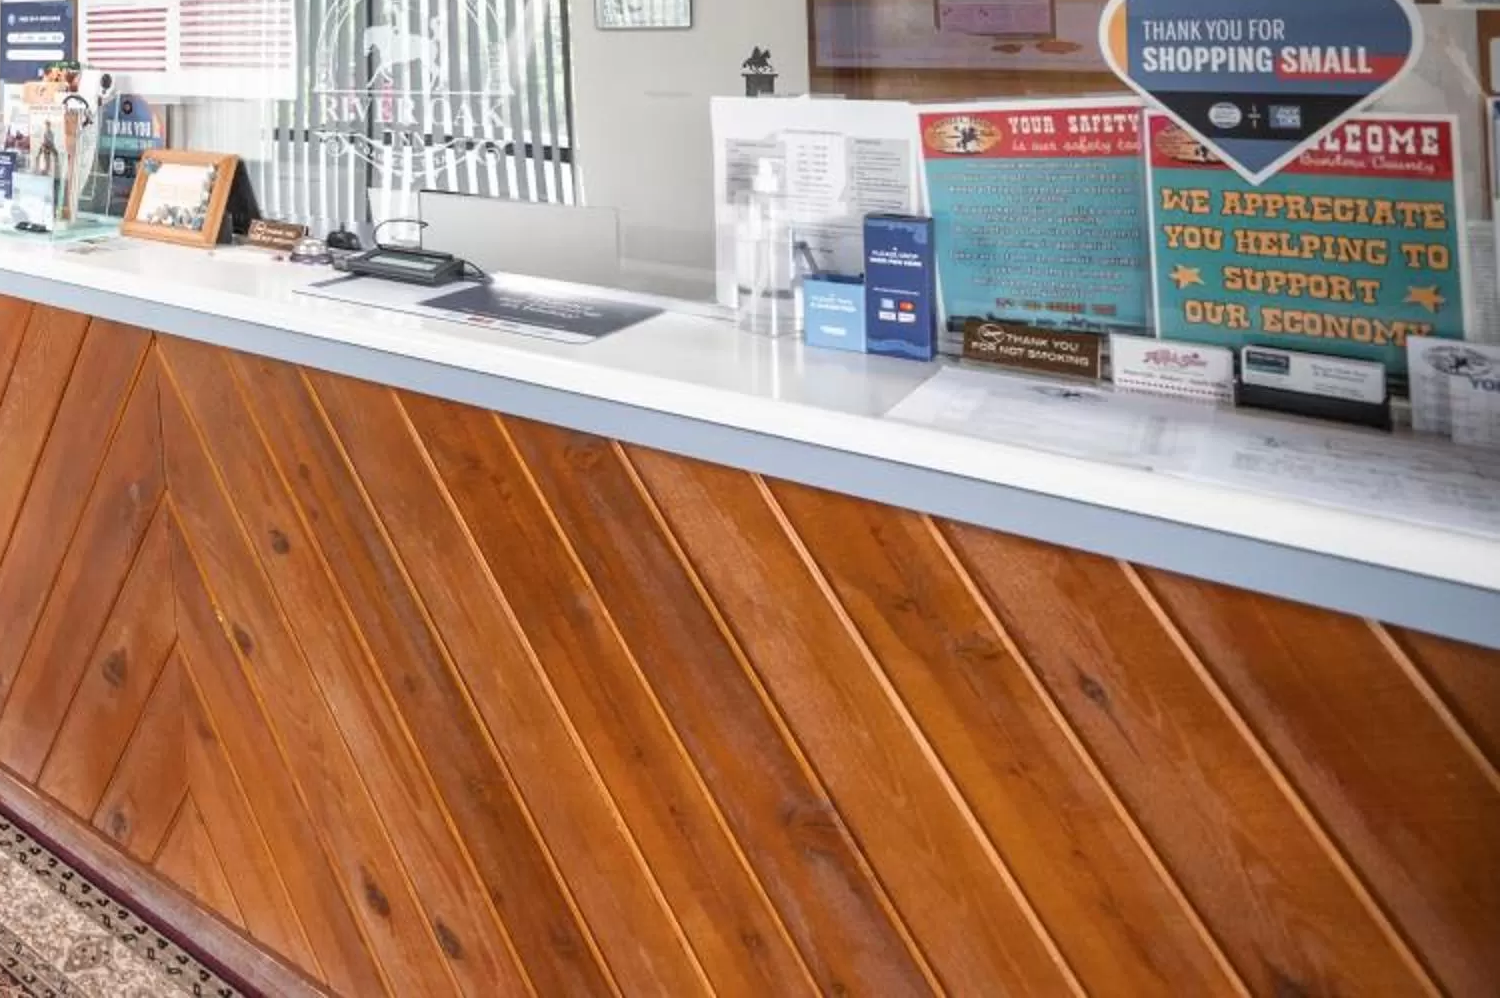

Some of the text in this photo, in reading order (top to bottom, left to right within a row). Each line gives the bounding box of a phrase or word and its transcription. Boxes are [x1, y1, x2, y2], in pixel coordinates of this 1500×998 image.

[1142, 19, 1285, 41] THANK YOU FOR
[1142, 47, 1373, 75] SHOPPING SMALL
[1007, 113, 1139, 134] YOUR SAFETY
[1308, 123, 1439, 155] LCOME
[1161, 187, 1210, 214] WE
[1221, 189, 1447, 230] APPRECIATE
[1164, 224, 1222, 251] YOU
[1234, 228, 1388, 266] HELPING
[1402, 243, 1449, 270] TO
[1223, 266, 1380, 304] SUPPORT
[1184, 299, 1249, 329] OUR
[971, 341, 1089, 367] FOR NOT SMOKING
[1006, 333, 1080, 353] THANK YOU
